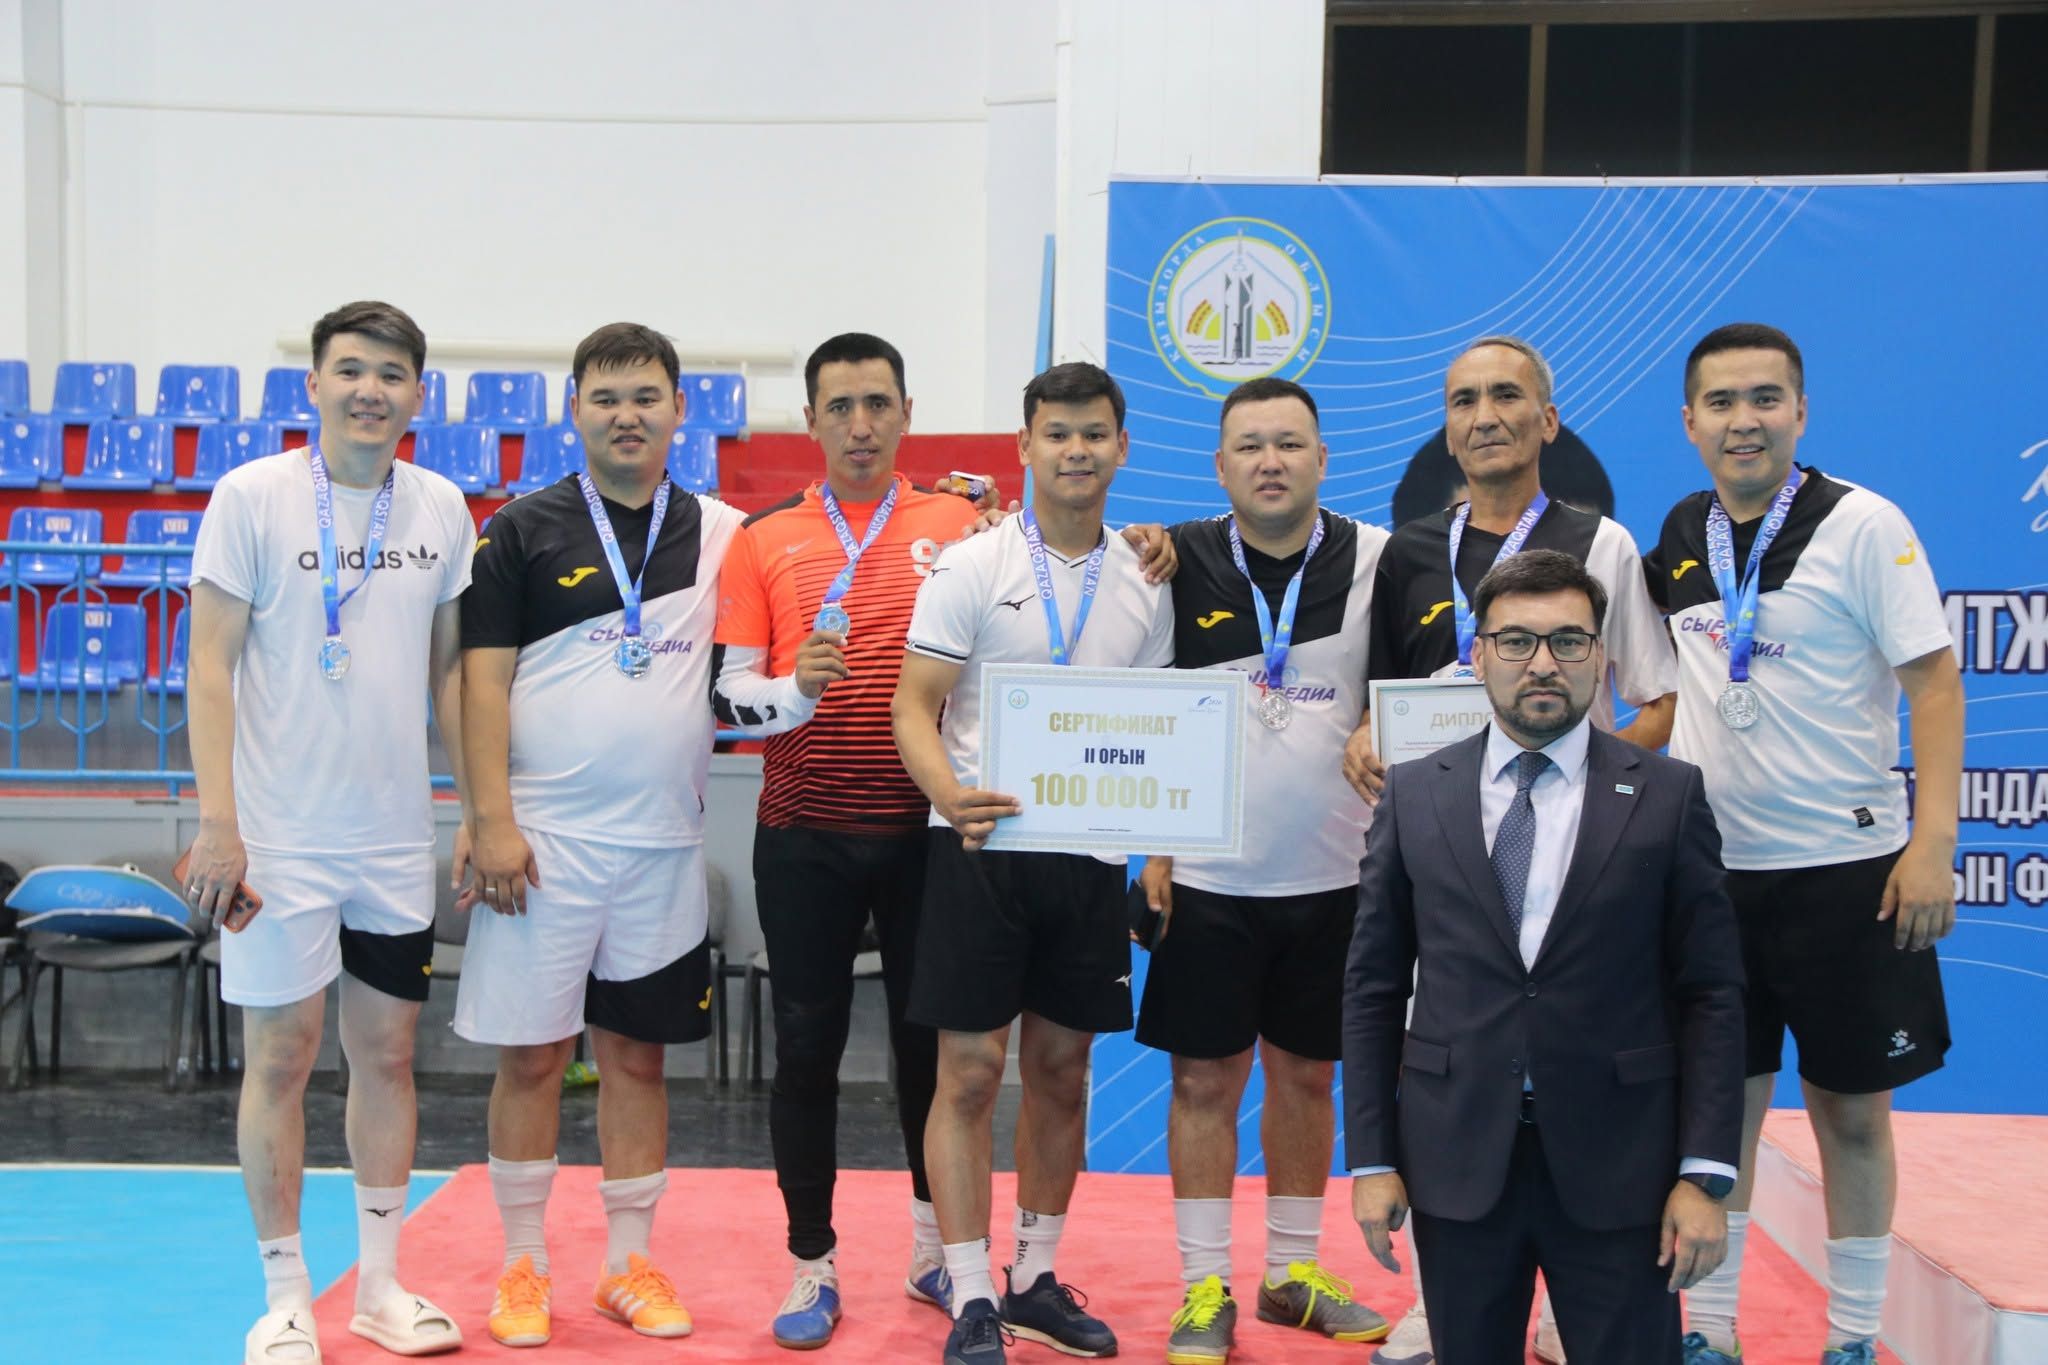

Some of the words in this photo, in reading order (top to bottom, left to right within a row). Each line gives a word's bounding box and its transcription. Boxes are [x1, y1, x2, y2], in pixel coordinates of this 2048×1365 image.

[311, 455, 332, 529] QAZAQSTAN
[298, 546, 403, 570] aidas
[1025, 524, 1053, 600] QAZAQSTAN
[1280, 687, 1337, 703] ЕДИА
[1049, 712, 1177, 735] СЕРТИФИКАТ
[1099, 748, 1145, 765] ОРЫН
[1031, 773, 1087, 807] 100
[1096, 774, 1159, 809] 000
